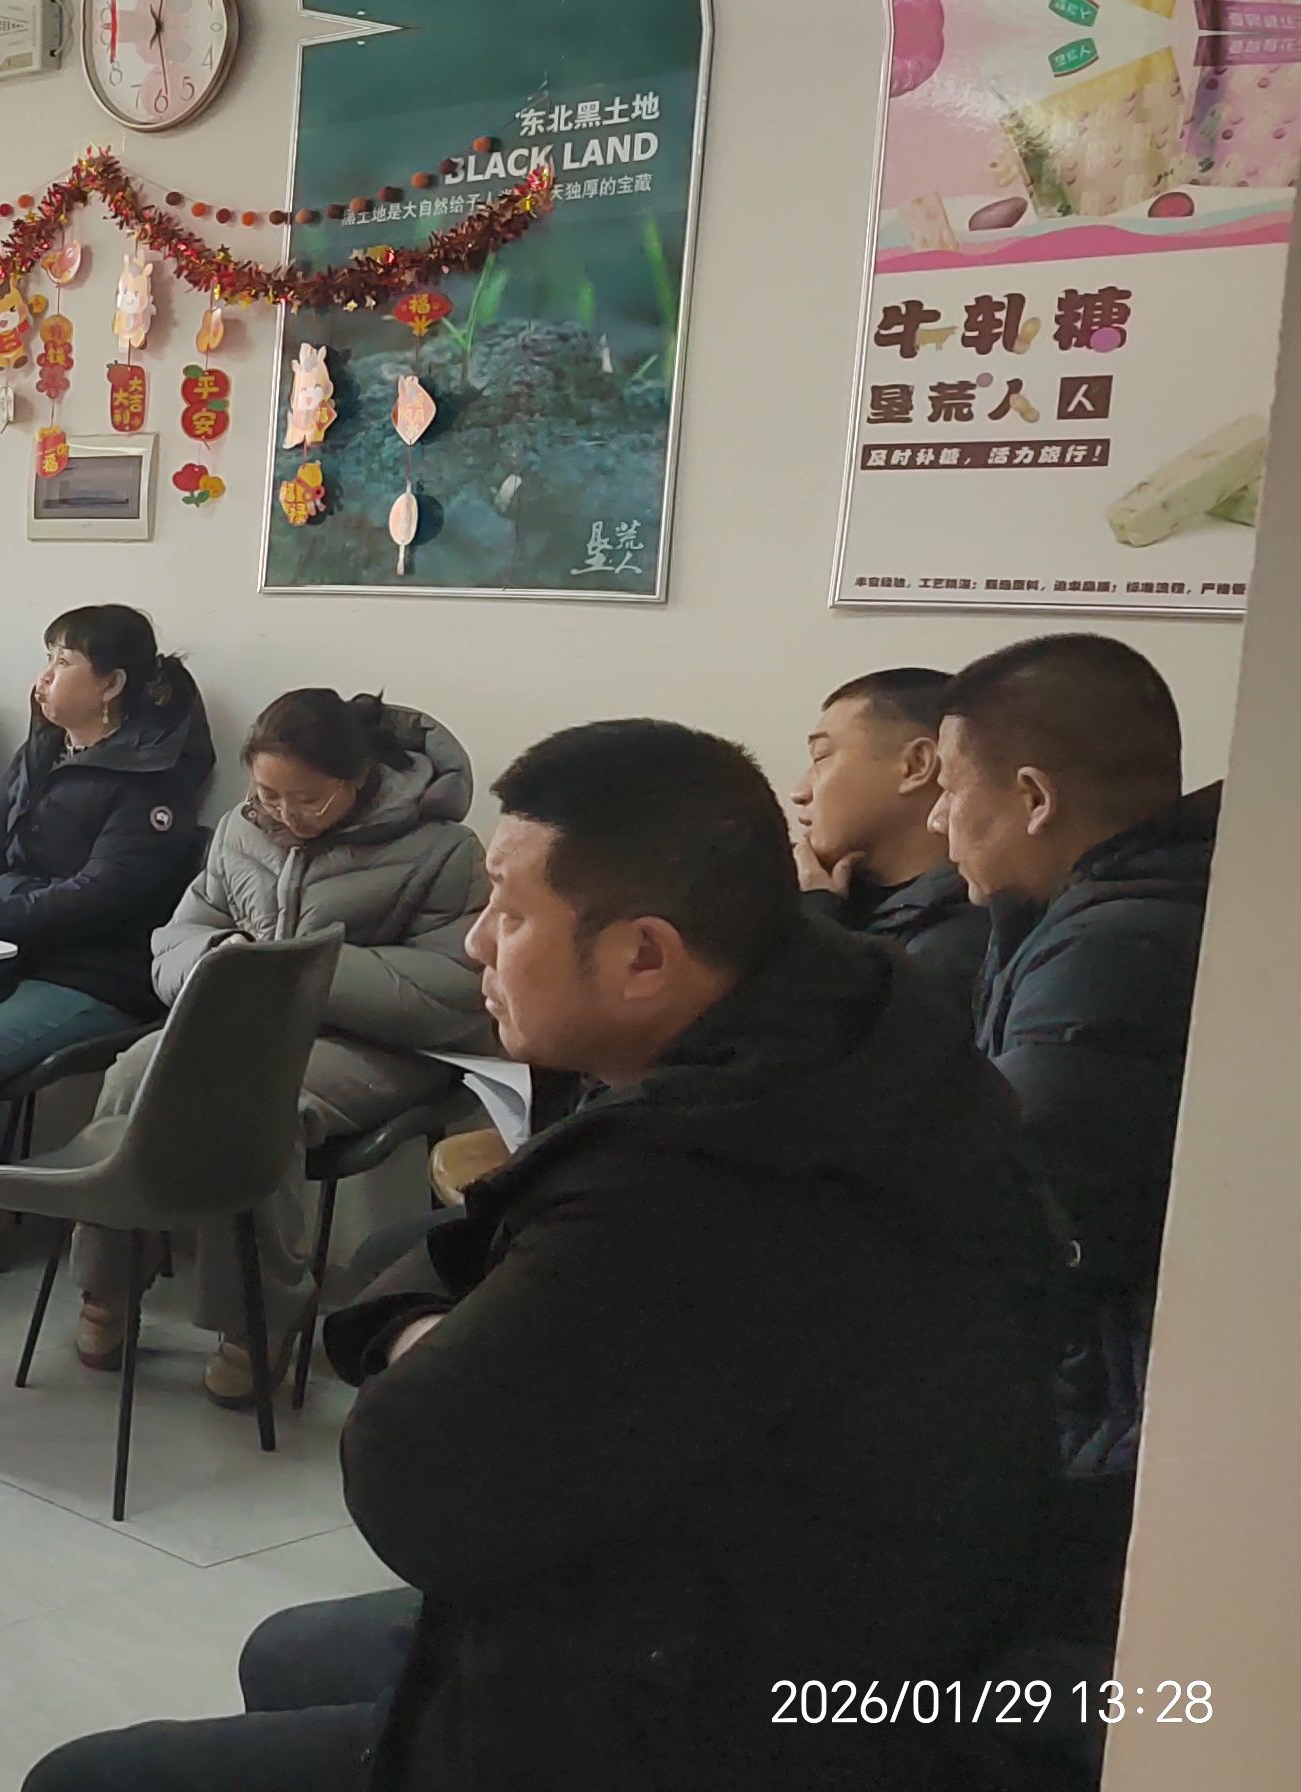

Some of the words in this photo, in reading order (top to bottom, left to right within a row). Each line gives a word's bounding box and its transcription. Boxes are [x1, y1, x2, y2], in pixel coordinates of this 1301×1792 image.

[201, 44, 214, 71] 4
[131, 84, 142, 109] 7
[153, 88, 169, 113] 6
[179, 76, 195, 101] 5
[519, 91, 661, 137] 东北黑土地
[444, 143, 555, 185] BLACK
[562, 132, 660, 170] LAND
[409, 293, 431, 315] 福
[874, 286, 1132, 359] 牛轧糖
[192, 375, 219, 435] 平安
[866, 378, 1040, 424] 垦荒人
